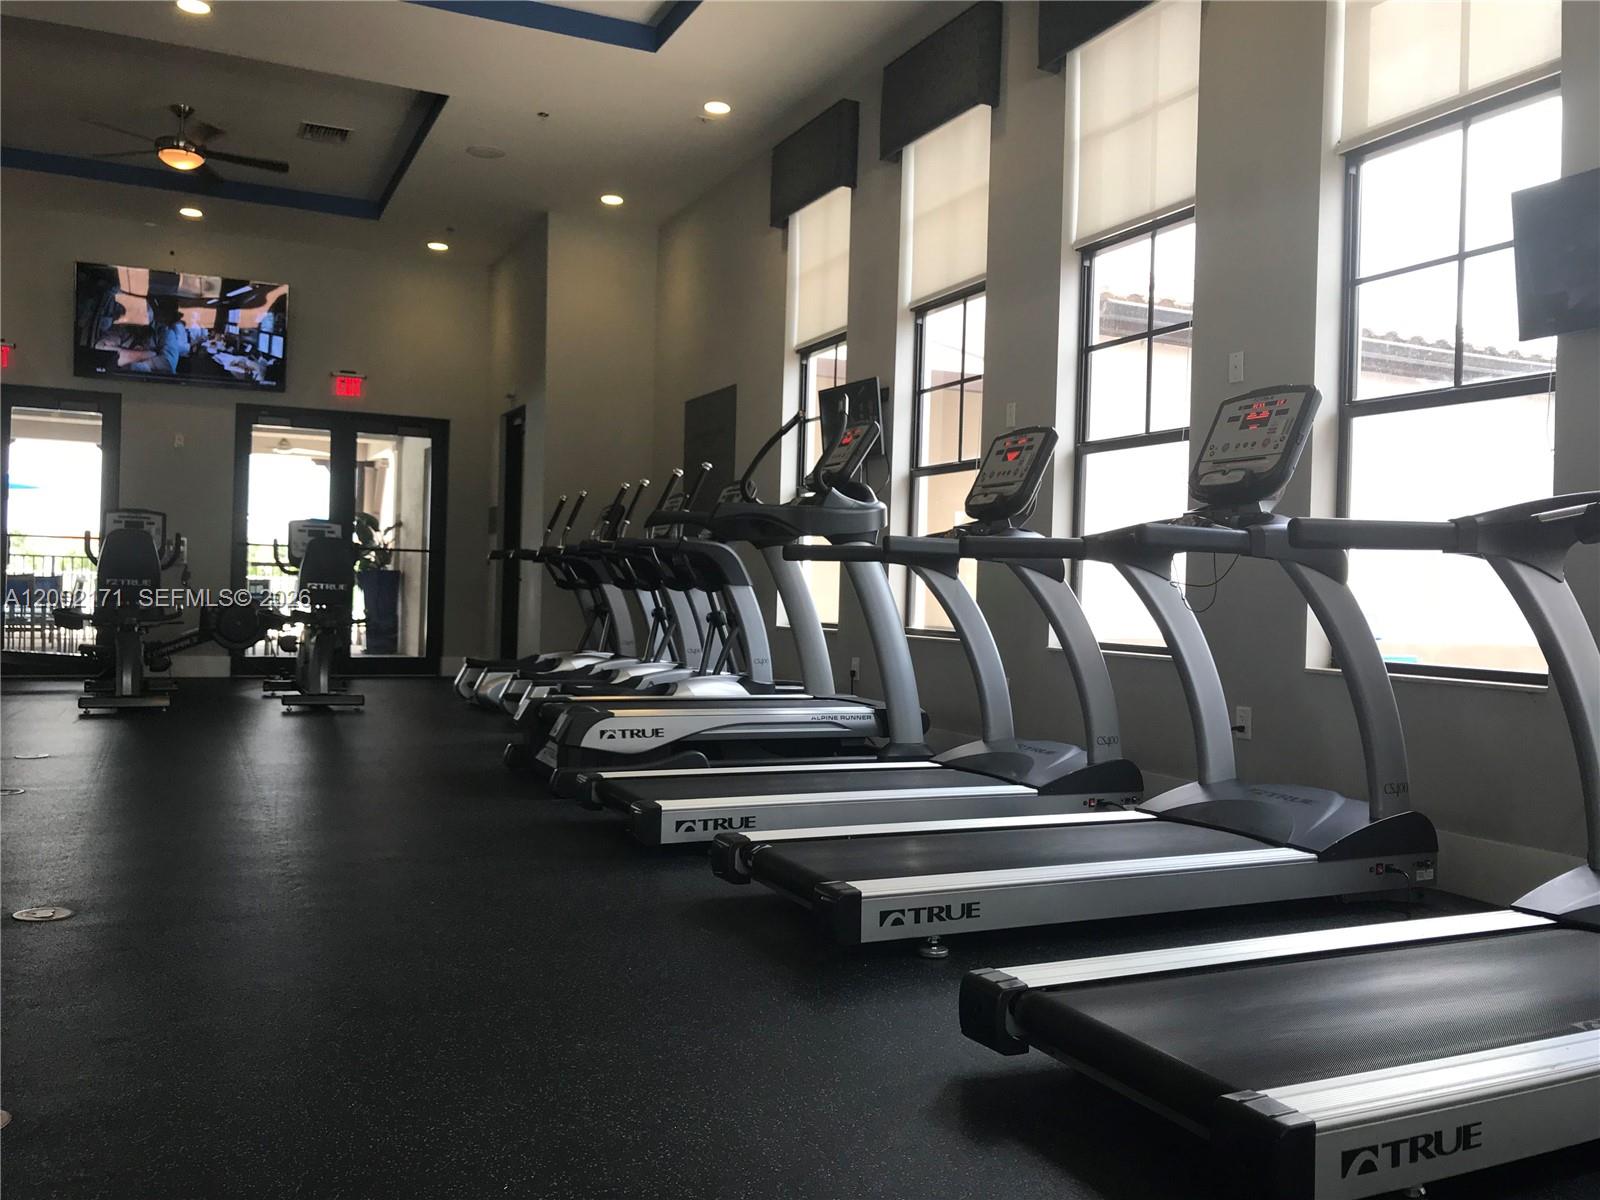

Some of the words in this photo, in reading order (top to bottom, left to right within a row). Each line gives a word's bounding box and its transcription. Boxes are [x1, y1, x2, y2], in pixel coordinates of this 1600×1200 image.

[617, 727, 665, 739] TRUE
[698, 816, 757, 830] TRUE
[907, 902, 981, 924] TRUE
[1382, 1121, 1482, 1168] TRUE
